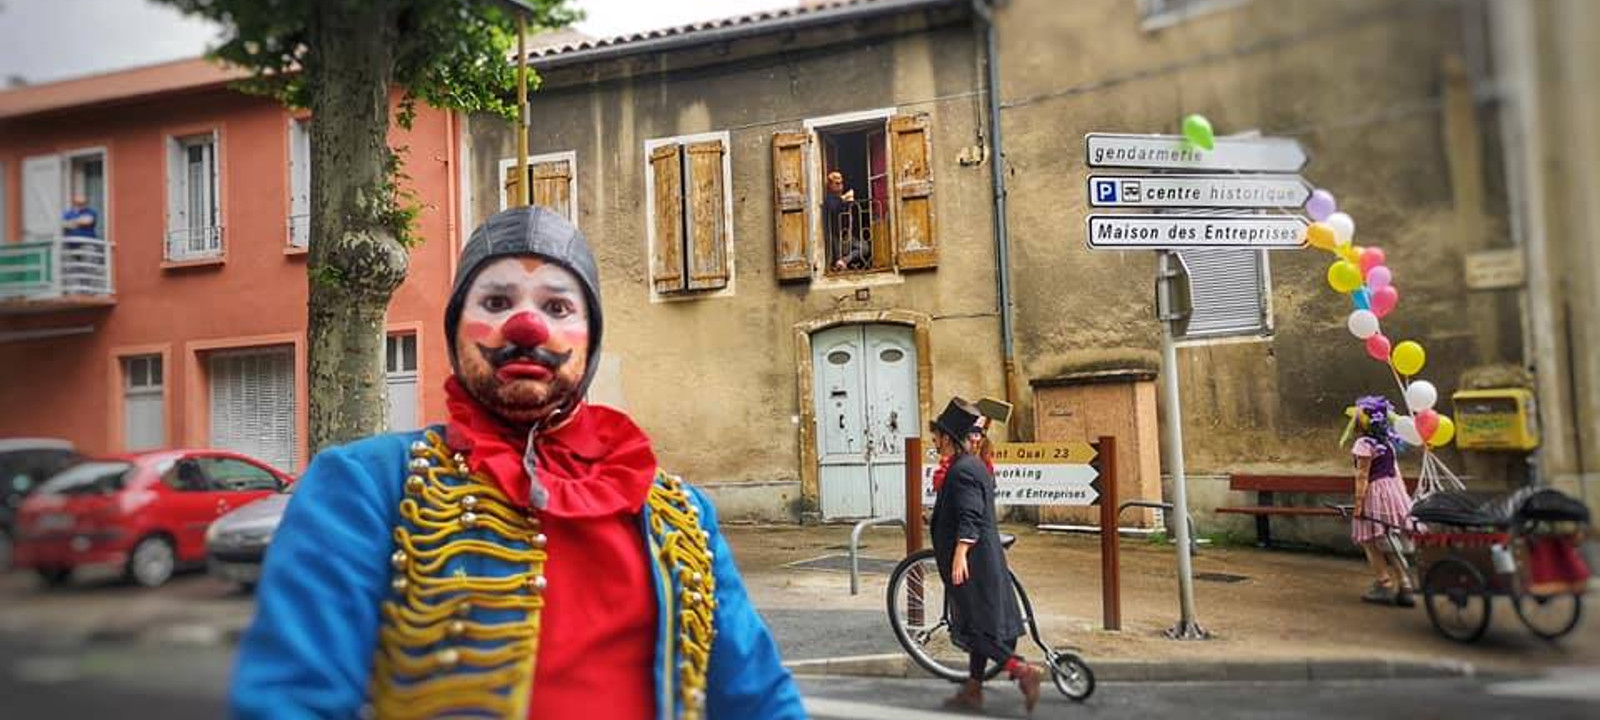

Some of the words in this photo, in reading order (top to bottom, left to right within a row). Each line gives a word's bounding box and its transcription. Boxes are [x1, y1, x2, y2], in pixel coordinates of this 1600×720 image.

[1095, 145, 1203, 163] gendarmerie
[1146, 186, 1201, 201] centre
[1210, 185, 1295, 203] historique
[1097, 223, 1159, 239] Maison
[1168, 224, 1196, 239] des
[1204, 224, 1298, 242] Entreprises
[1053, 448, 1069, 459] 23
